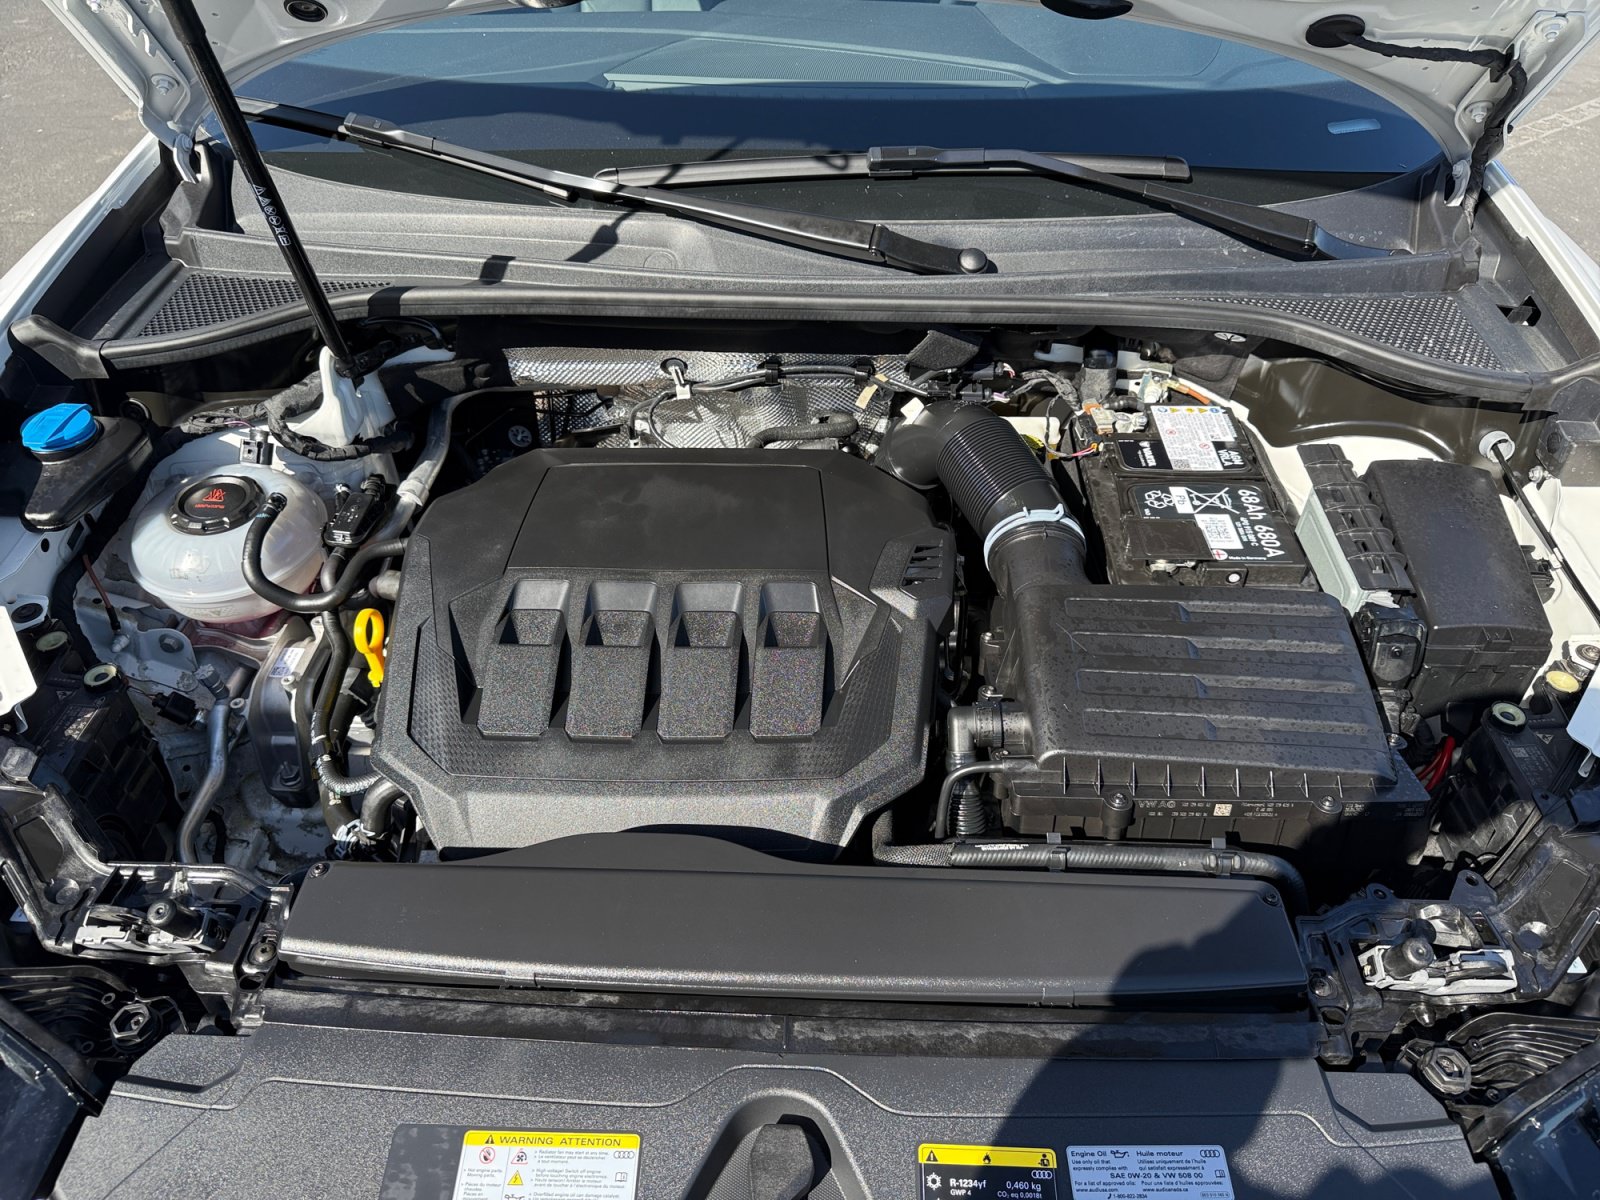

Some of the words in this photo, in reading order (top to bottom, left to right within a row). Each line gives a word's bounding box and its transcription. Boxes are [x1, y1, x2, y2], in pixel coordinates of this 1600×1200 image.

[1218, 450, 1234, 467] VRLA
[1229, 450, 1245, 466] AGM
[1175, 494, 1187, 505] Pb
[1238, 489, 1267, 520] 68Ah
[1254, 525, 1285, 558] 680A
[1138, 800, 1158, 808] VW
[1158, 800, 1176, 808] AG
[500, 1136, 554, 1145] WARNING
[560, 1137, 621, 1147] ATTENTION
[949, 1178, 987, 1190] R-1234yf
[1006, 1181, 1030, 1190] 0,460
[1031, 1182, 1042, 1192] kg
